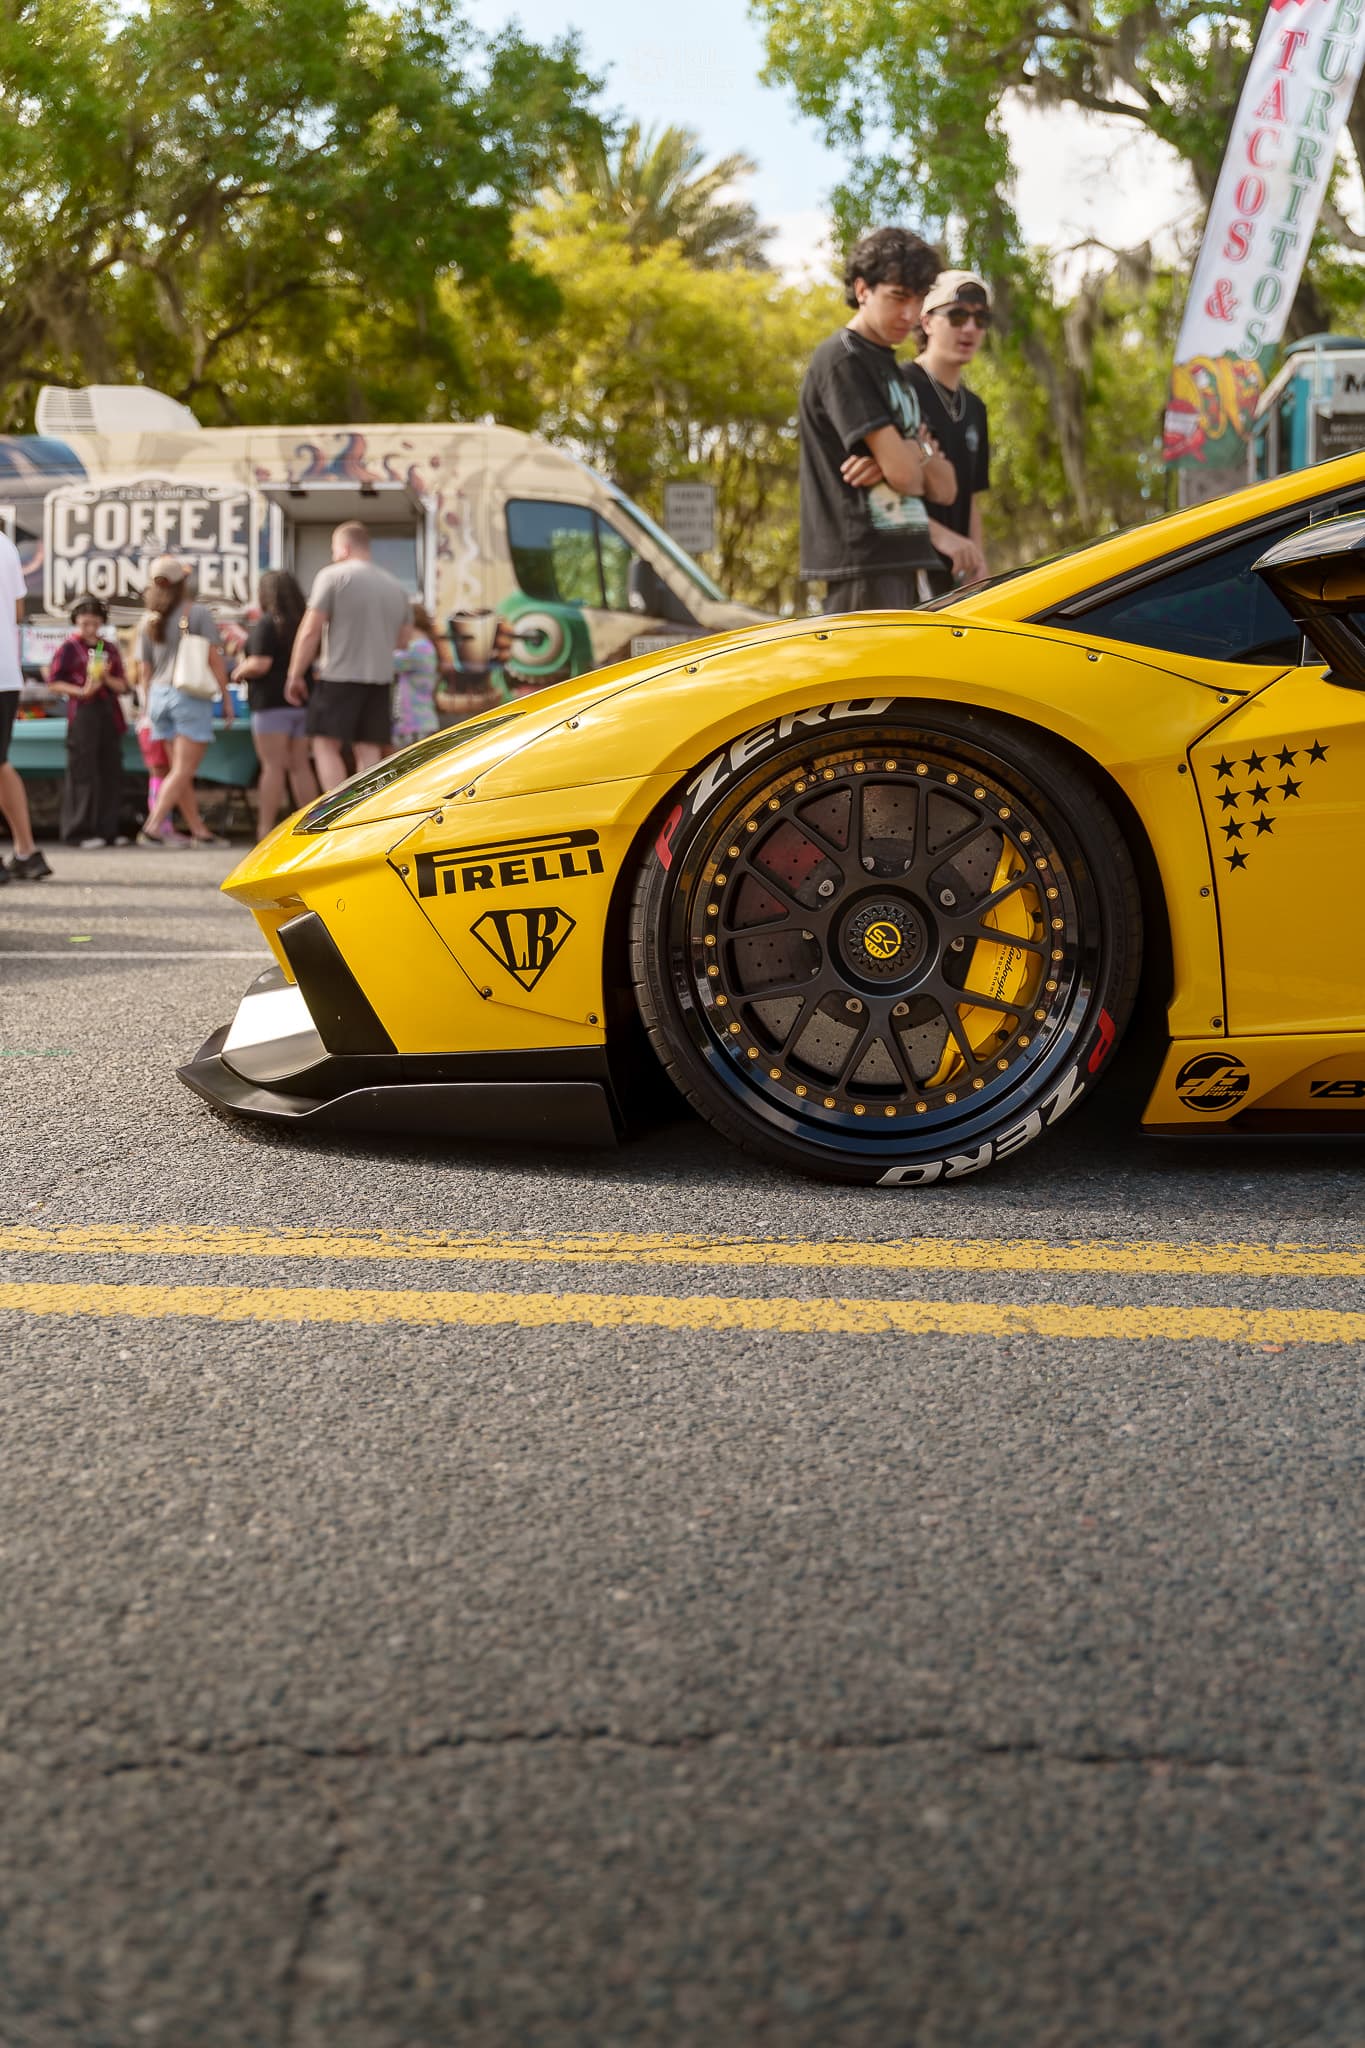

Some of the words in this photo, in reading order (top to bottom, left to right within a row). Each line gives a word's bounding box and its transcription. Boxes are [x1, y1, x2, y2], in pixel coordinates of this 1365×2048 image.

[1222, 29, 1308, 263] TACOS
[1204, 278, 1238, 322] &
[53, 500, 250, 557] COFFEE
[686, 697, 897, 815] ZERO
[414, 828, 605, 899] PIRELLI
[875, 1065, 1086, 1186] ZERO
